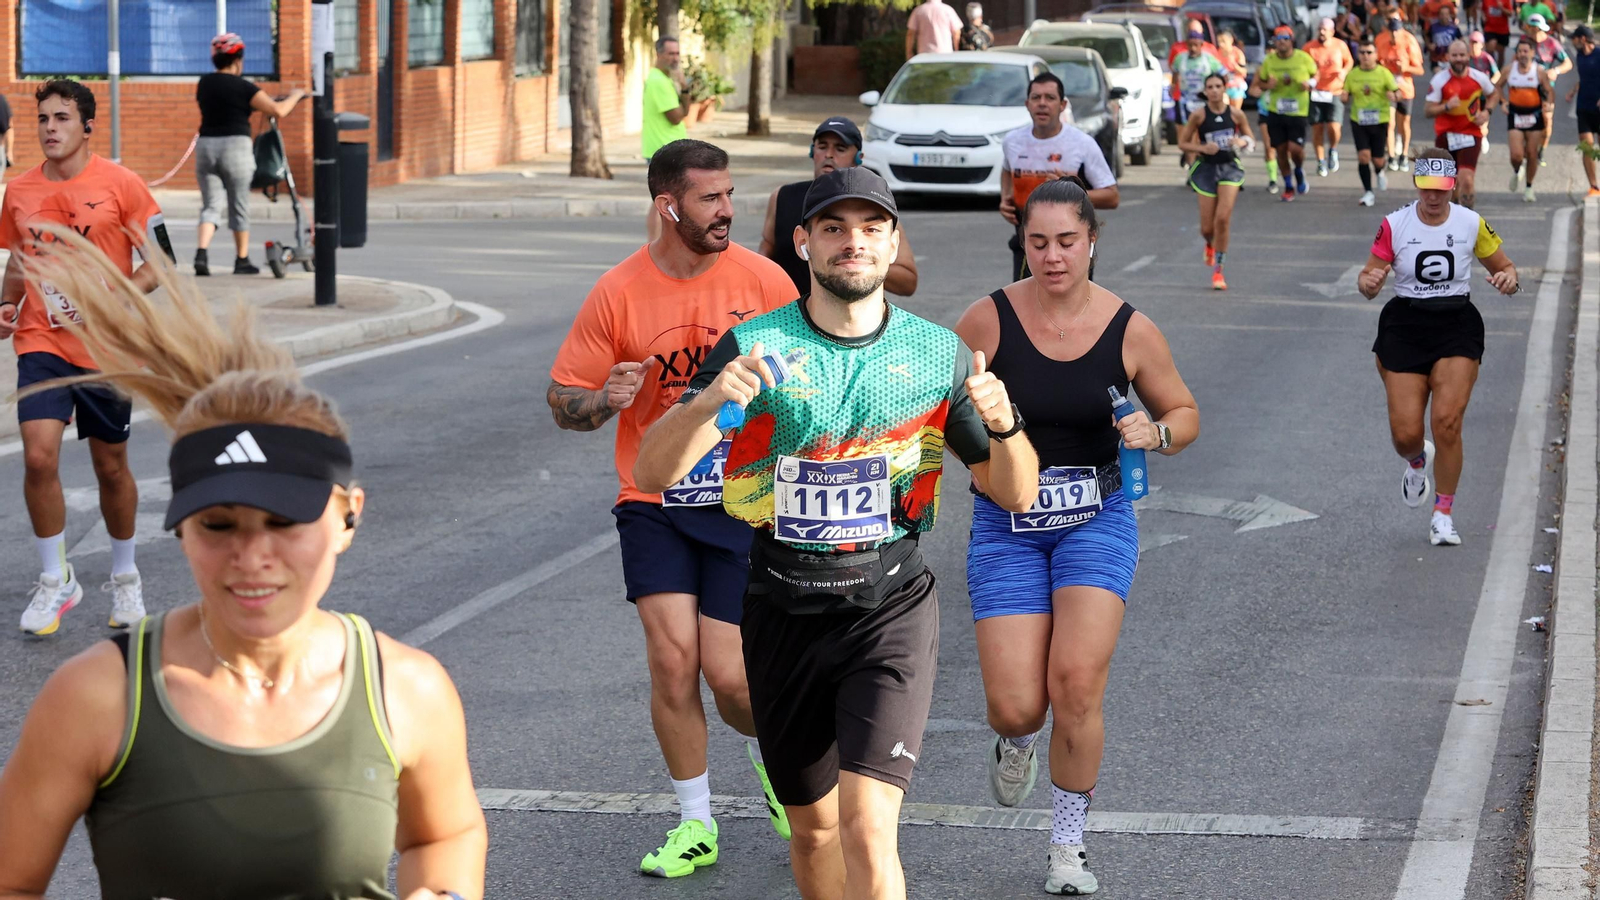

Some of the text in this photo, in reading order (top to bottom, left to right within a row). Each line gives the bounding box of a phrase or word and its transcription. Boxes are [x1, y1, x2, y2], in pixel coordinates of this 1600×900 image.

[1413, 283, 1451, 292] asadens
[794, 486, 873, 517] 1112
[1030, 483, 1084, 509] 019
[1044, 510, 1096, 526] MIZUNO
[816, 522, 884, 539] MIZUNO
[782, 575, 811, 588] EXERCISE
[833, 577, 865, 588] FREEDOM
